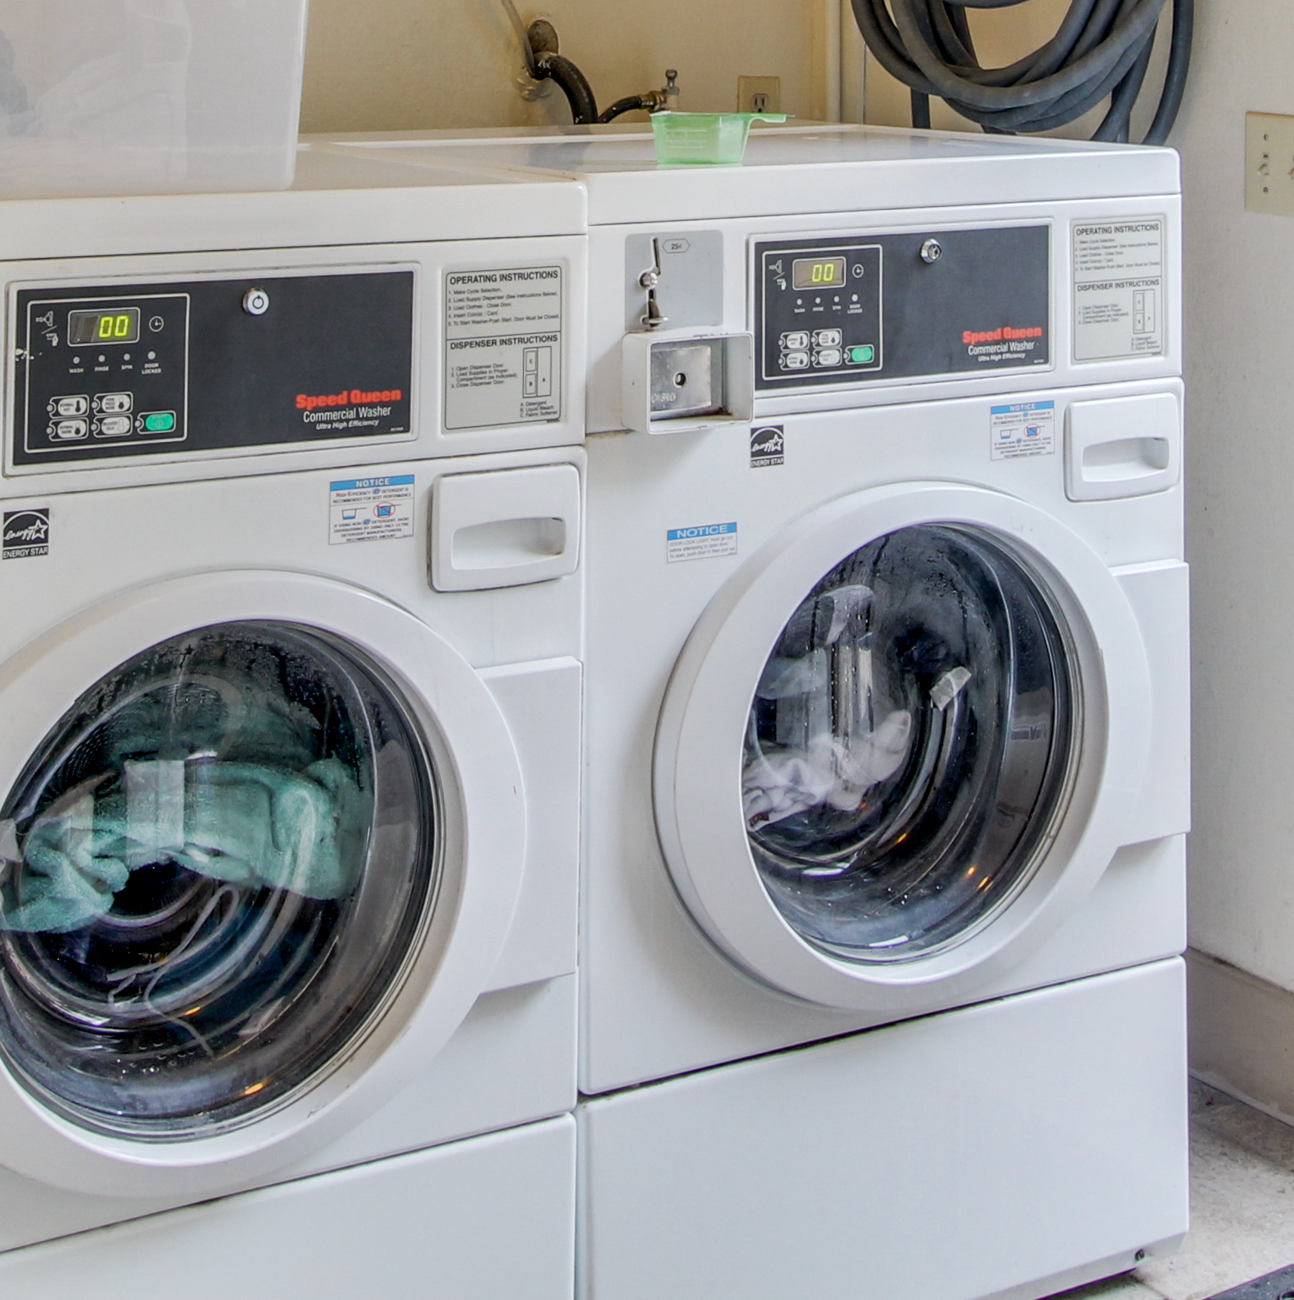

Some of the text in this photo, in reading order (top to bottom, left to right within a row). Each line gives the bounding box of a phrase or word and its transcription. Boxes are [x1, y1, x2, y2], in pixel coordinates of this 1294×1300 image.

[1076, 224, 1159, 236] OPERATING INSTRUCTIONS
[450, 270, 558, 285] OPERATING INSTRUCTIONS
[812, 264, 834, 282] 00
[1077, 279, 1159, 292] DISPENSER INSTRUCTIONS
[99, 316, 129, 337] 00
[451, 334, 558, 350] DISPENSER INSTRUCTIONS
[962, 327, 1043, 344] Speed Queen
[968, 341, 1035, 355] Commercial Washer
[296, 389, 402, 410] Speed Queen
[303, 406, 392, 423] Commercial Washer
[356, 478, 390, 487] NOTICE
[677, 525, 728, 538] NOTICE
[4, 547, 48, 558] ENERGY STAR
